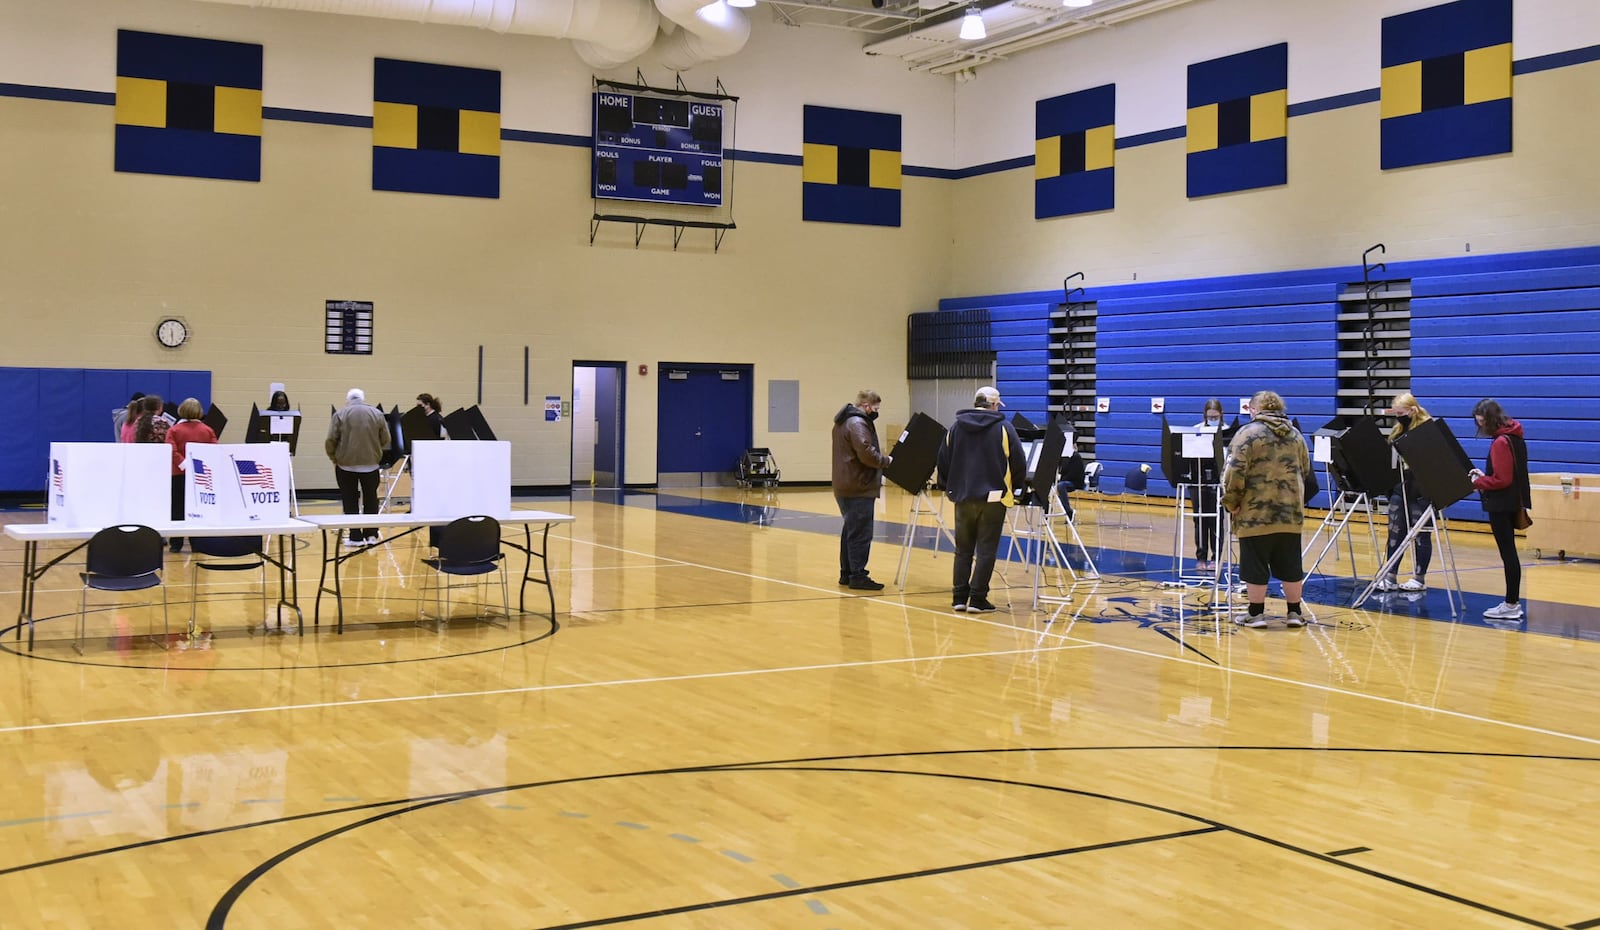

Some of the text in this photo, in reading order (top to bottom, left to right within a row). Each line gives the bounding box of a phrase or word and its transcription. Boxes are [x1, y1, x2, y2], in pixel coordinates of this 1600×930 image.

[600, 95, 628, 108] HOME
[692, 105, 722, 116] GUEST
[200, 492, 216, 504] VOTE
[251, 492, 280, 504] VOTE
